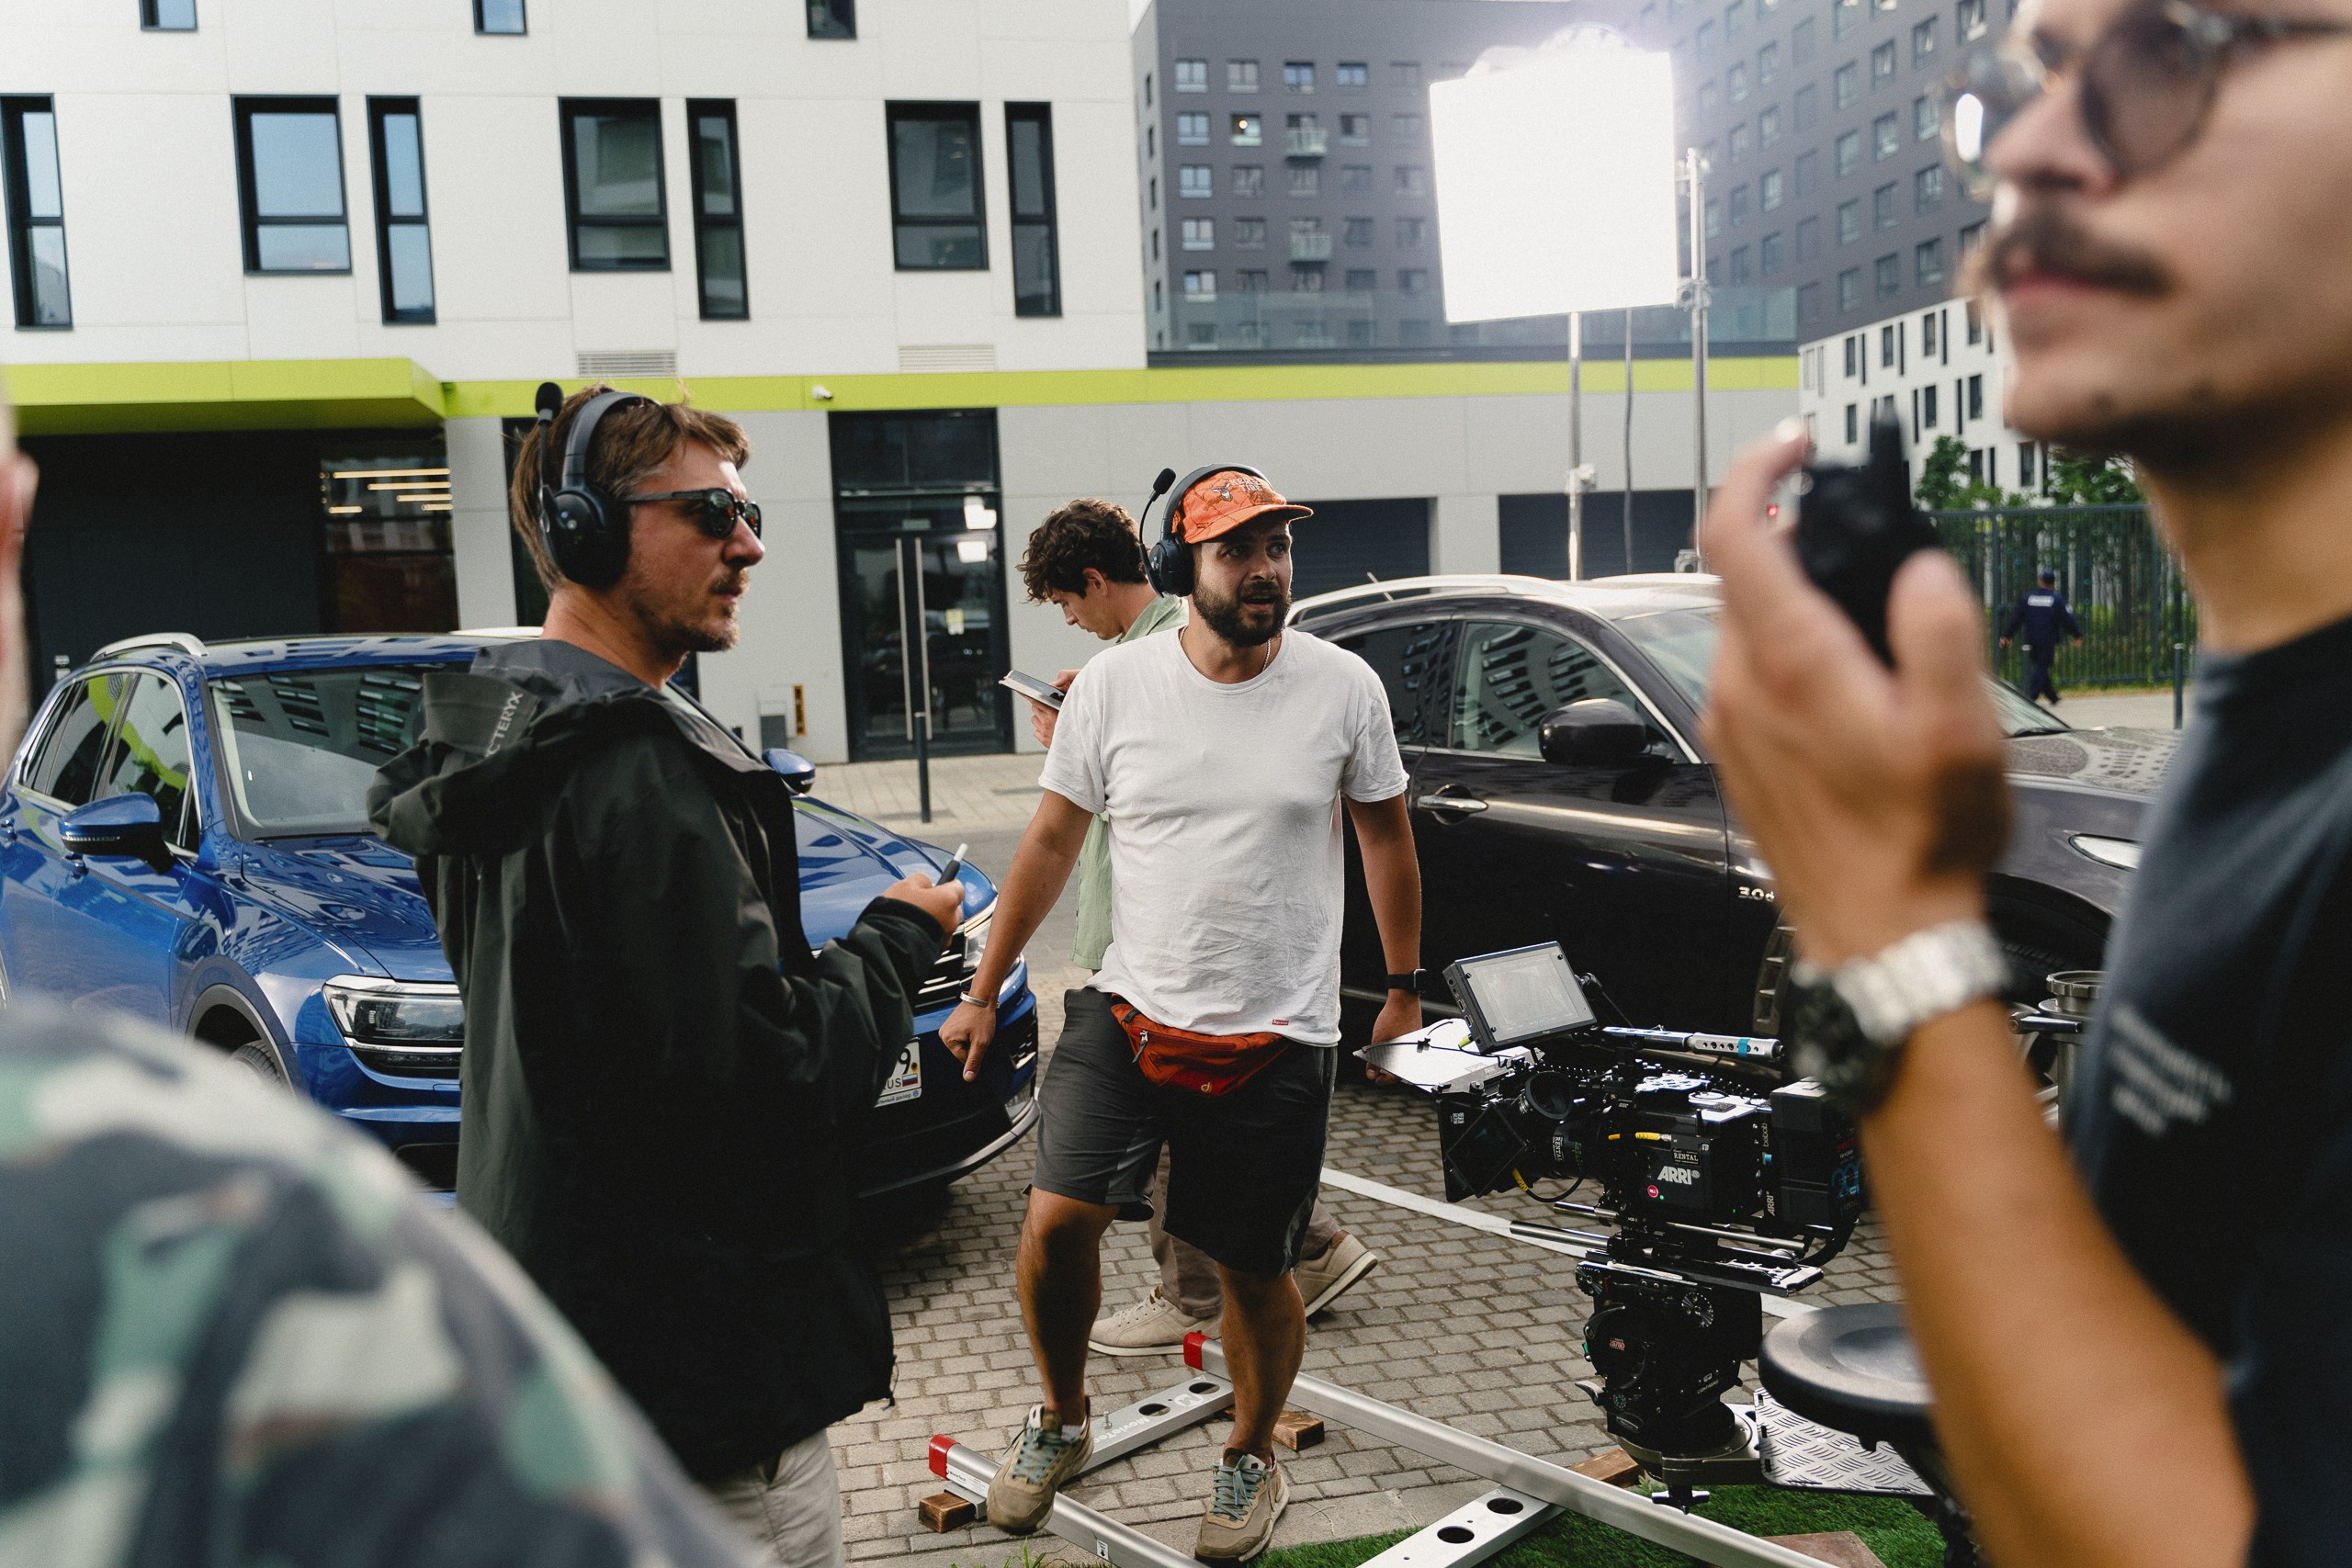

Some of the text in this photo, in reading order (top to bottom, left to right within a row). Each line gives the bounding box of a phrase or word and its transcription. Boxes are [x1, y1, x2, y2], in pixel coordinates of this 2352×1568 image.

[883, 1077, 902, 1090] US
[1673, 1152, 1699, 1162] RENTAL
[1657, 1166, 1692, 1186] ARRI
